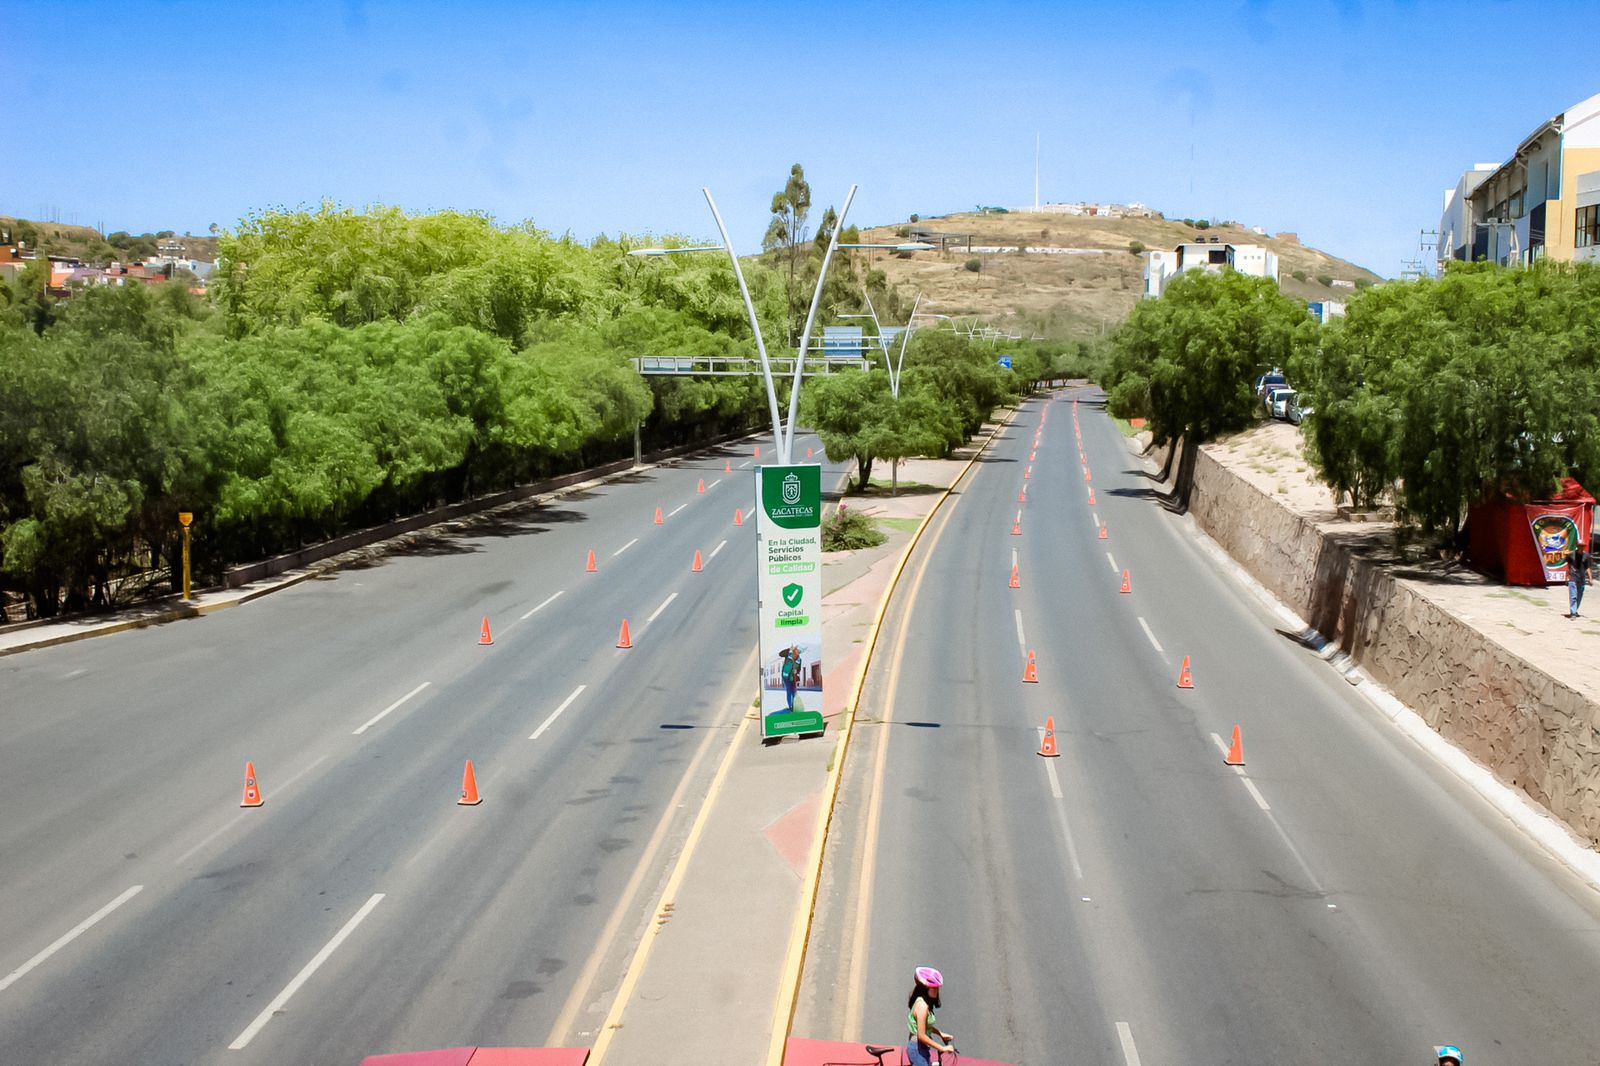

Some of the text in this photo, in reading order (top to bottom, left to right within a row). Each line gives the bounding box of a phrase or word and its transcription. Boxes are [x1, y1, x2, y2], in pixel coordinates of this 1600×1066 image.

[771, 506, 814, 515] ZACATECAS
[768, 546, 804, 554] Servicios
[768, 554, 802, 562] Públicos
[778, 609, 803, 618] Capital
[780, 617, 803, 626] limpia
